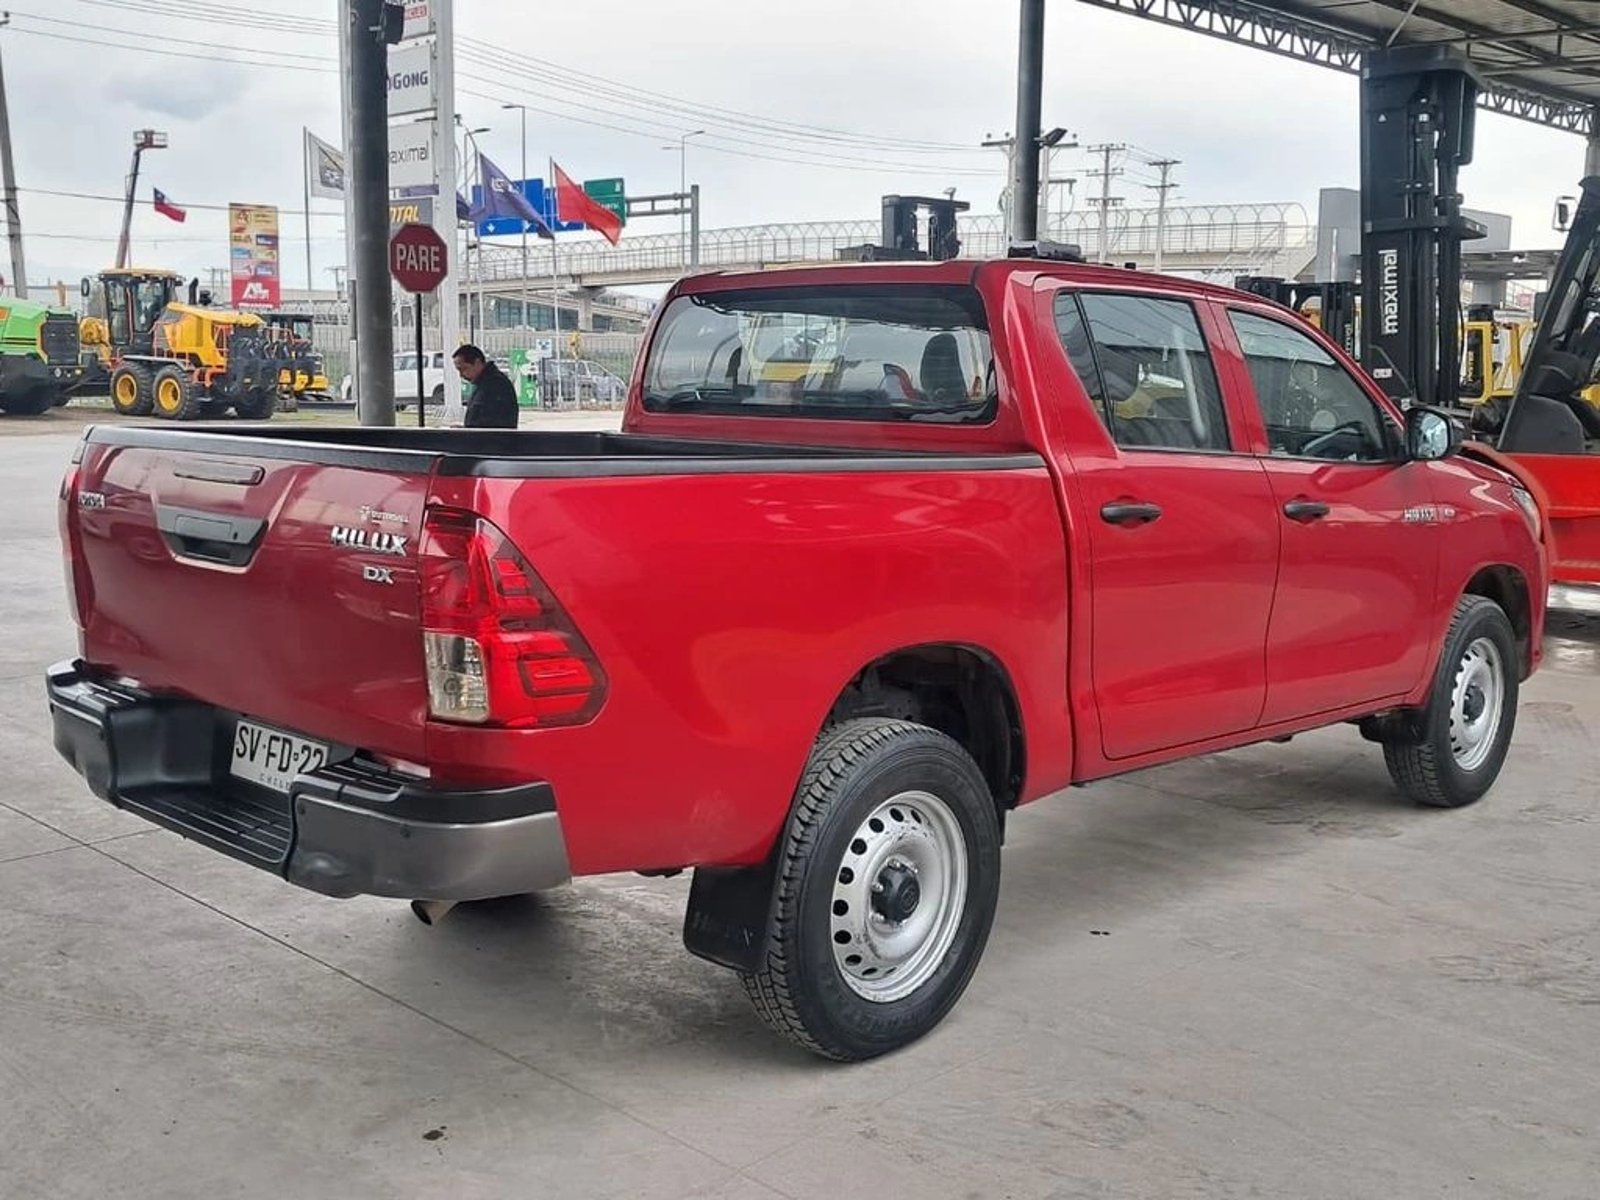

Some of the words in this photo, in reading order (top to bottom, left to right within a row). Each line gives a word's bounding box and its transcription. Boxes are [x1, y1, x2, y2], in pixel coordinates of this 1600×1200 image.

[388, 140, 429, 163] aximal
[395, 243, 441, 273] PARE
[1378, 249, 1398, 334] maximal
[331, 525, 407, 558] HILUX
[363, 566, 394, 585] DX
